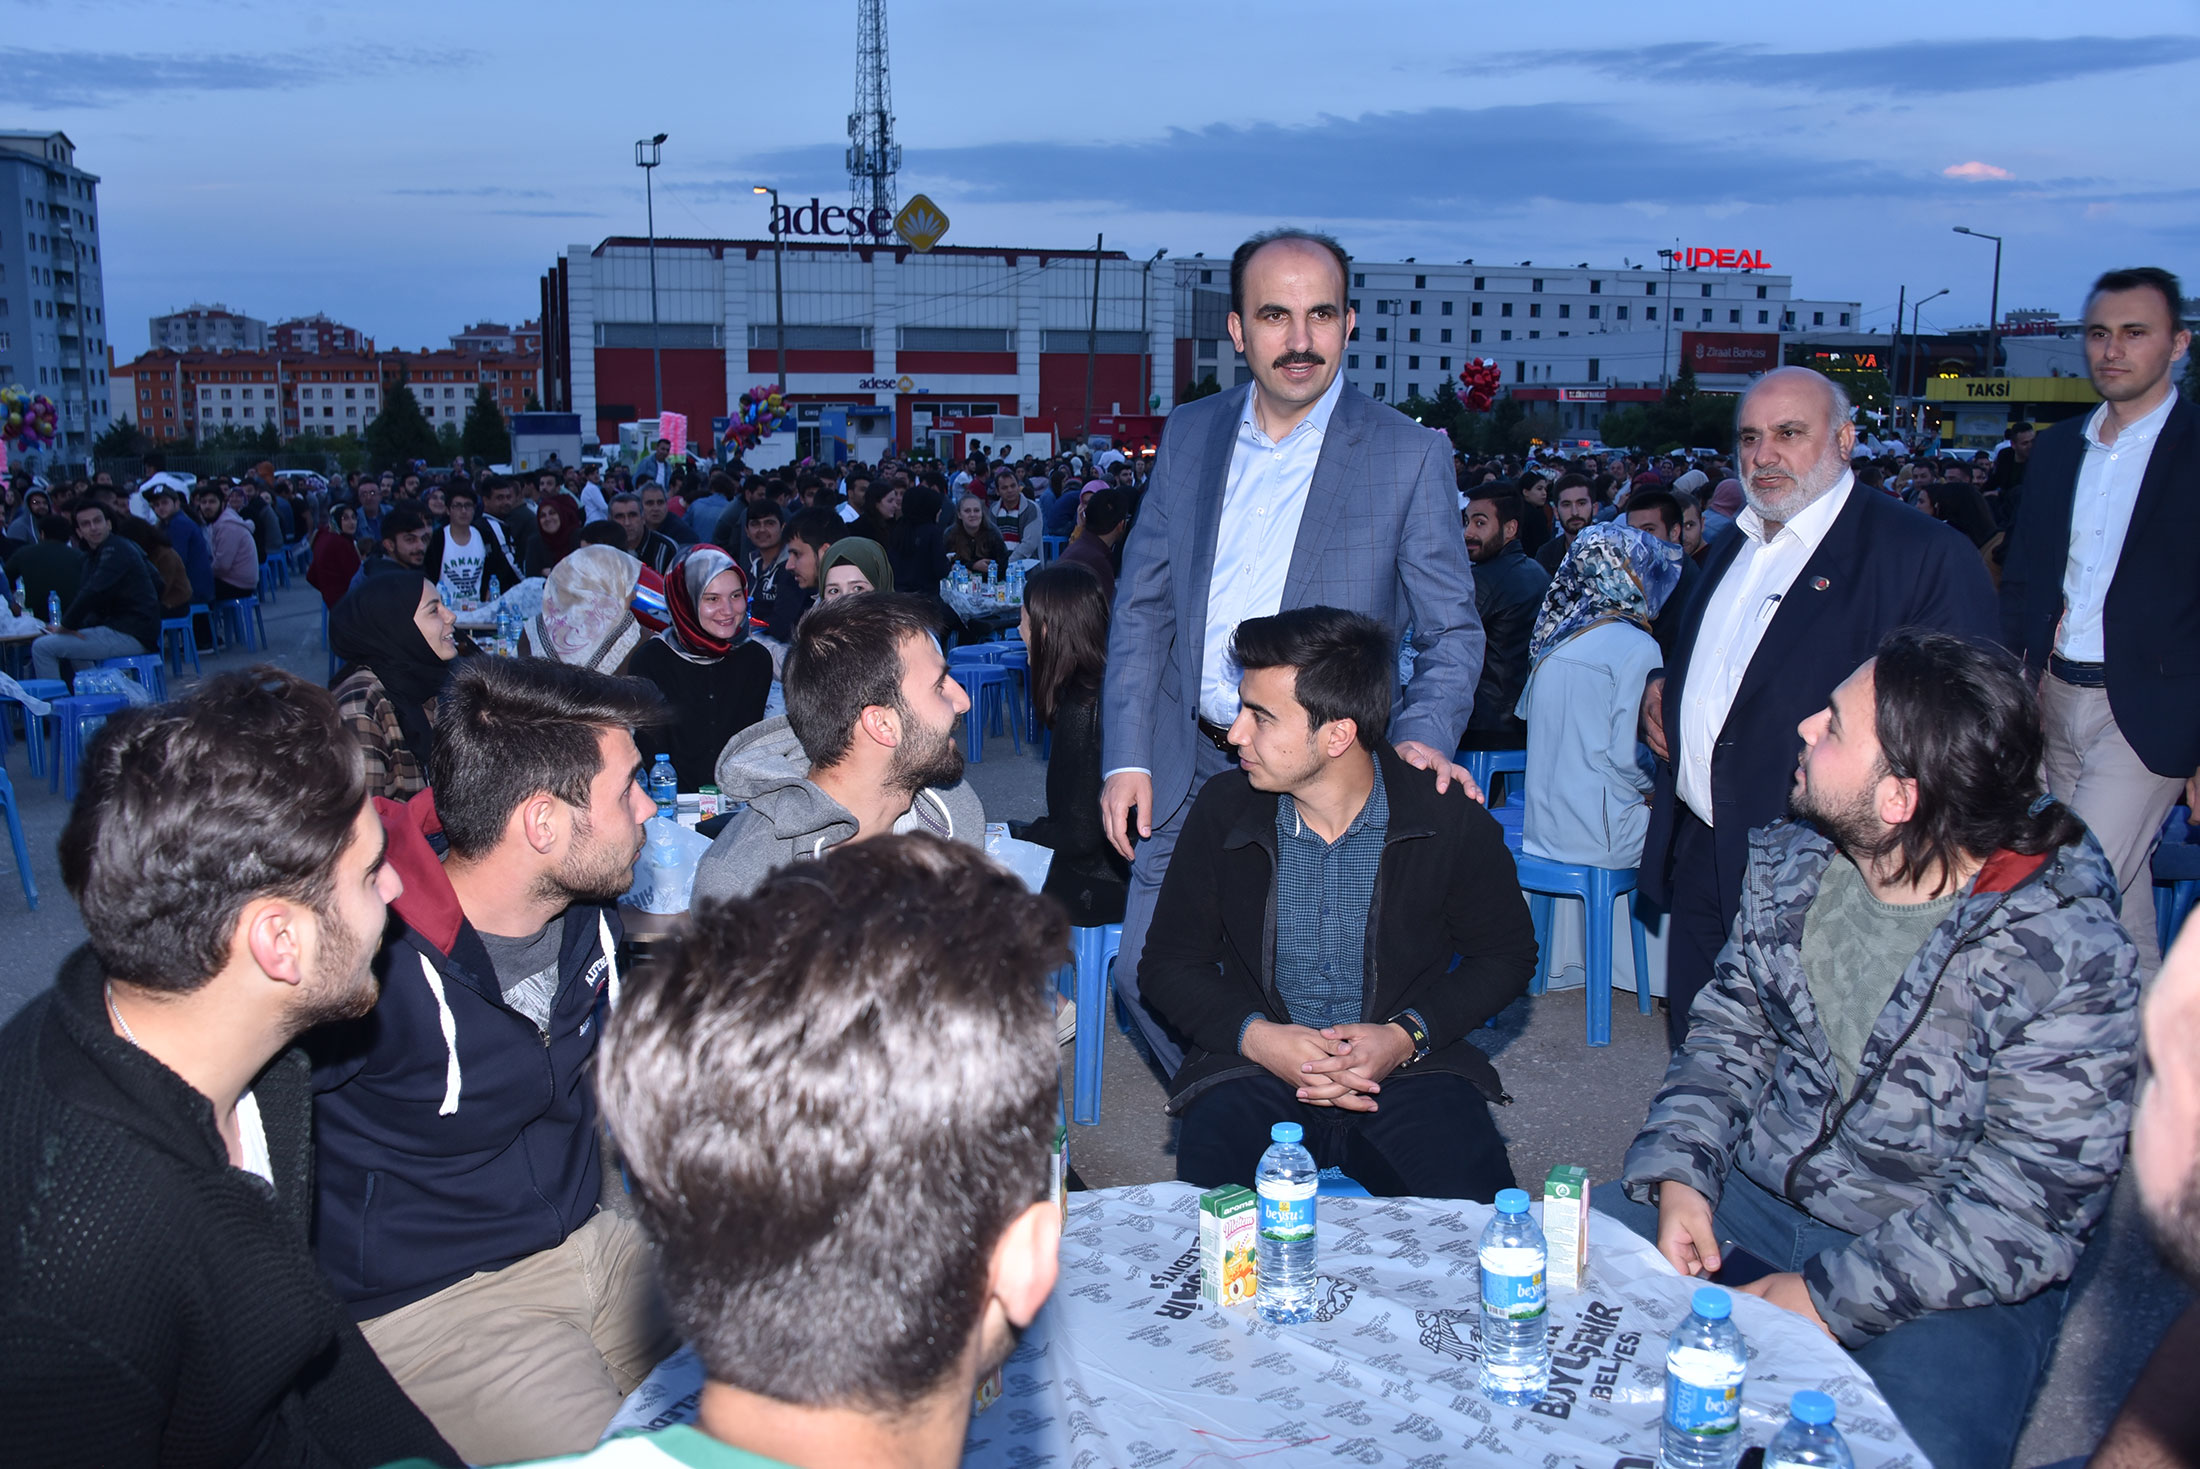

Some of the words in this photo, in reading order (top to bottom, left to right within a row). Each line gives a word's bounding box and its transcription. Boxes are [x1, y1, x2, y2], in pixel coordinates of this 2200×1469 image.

[768, 197, 893, 238] adese
[1686, 247, 1772, 268] IDEAL
[1706, 347, 1732, 358] Ziraat
[1733, 347, 1766, 359] Bankası
[859, 377, 896, 390] adese
[1966, 381, 2010, 397] TAKSİ
[1223, 1200, 1255, 1215] aroma
[1266, 1204, 1298, 1224] beysu
